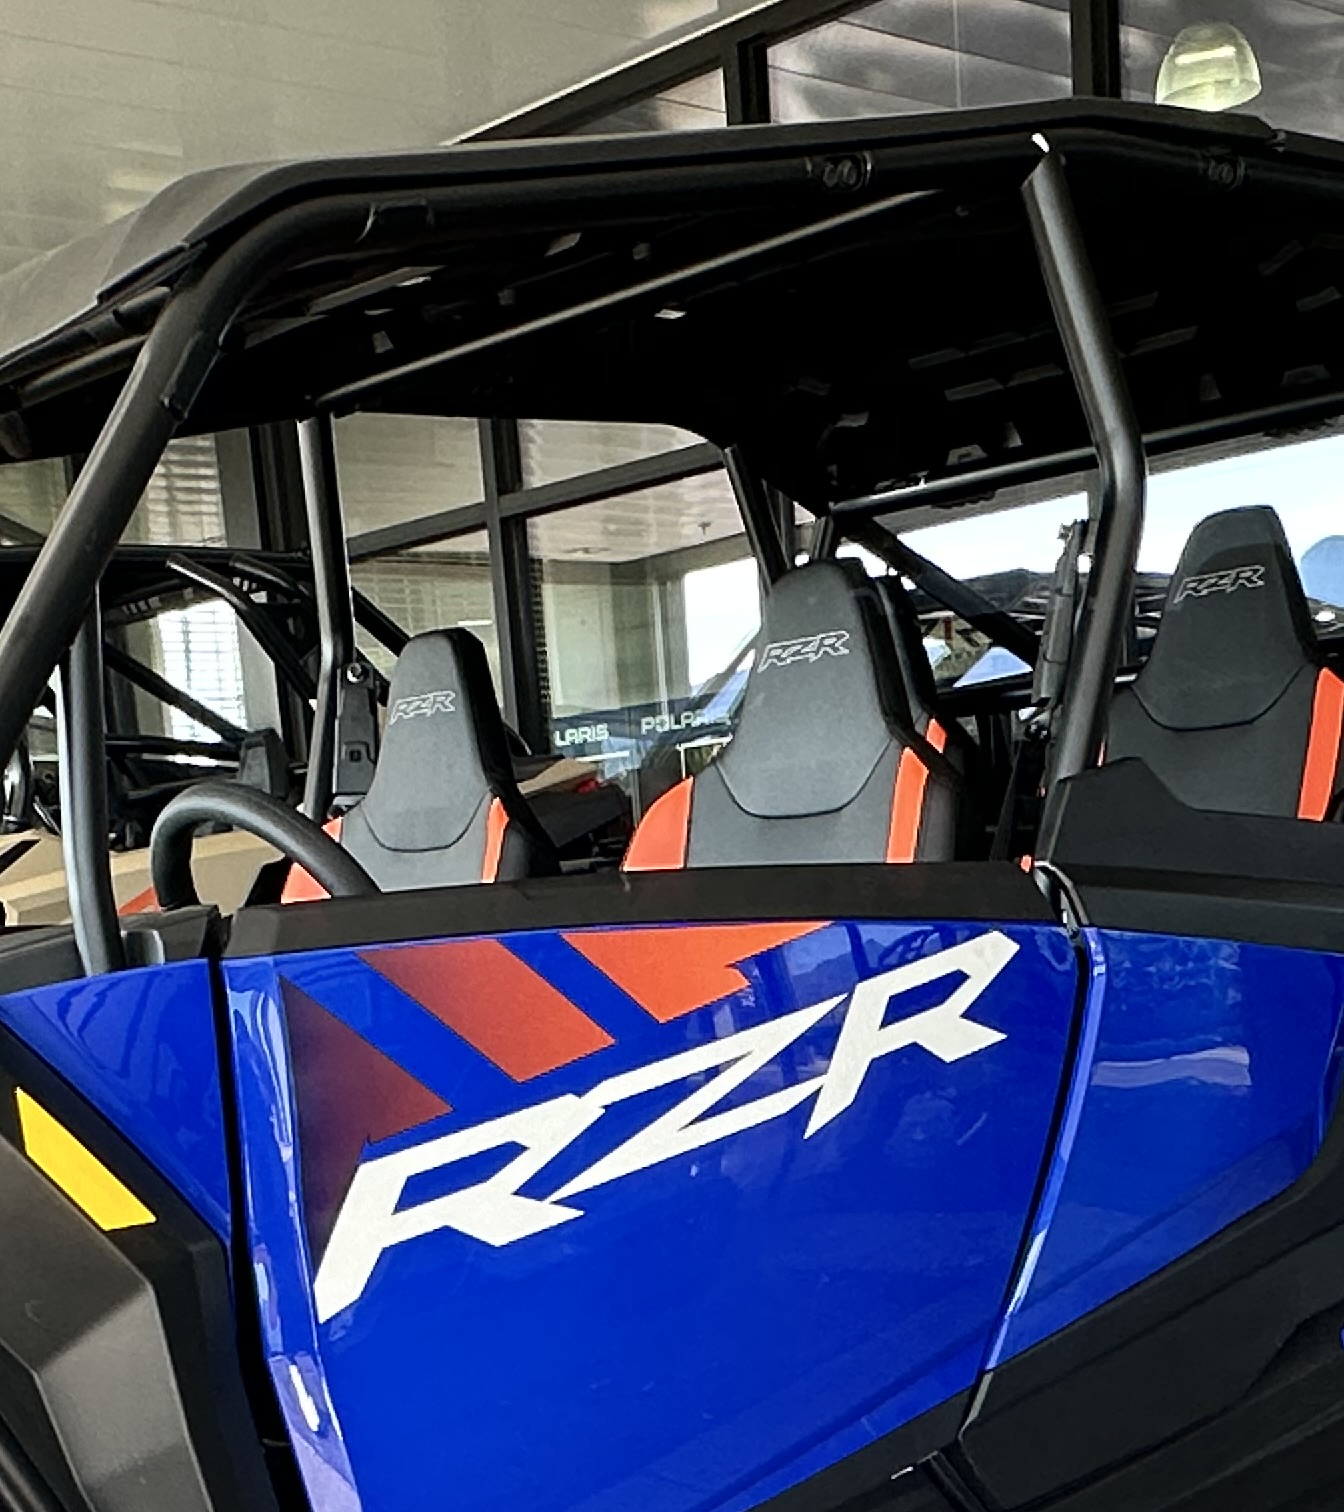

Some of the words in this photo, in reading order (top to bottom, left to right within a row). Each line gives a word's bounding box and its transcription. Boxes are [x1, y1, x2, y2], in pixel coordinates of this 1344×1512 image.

[1173, 564, 1265, 604] RZR
[757, 630, 850, 673] RZR
[389, 690, 456, 725] RZR
[313, 930, 1020, 1324] RZR
